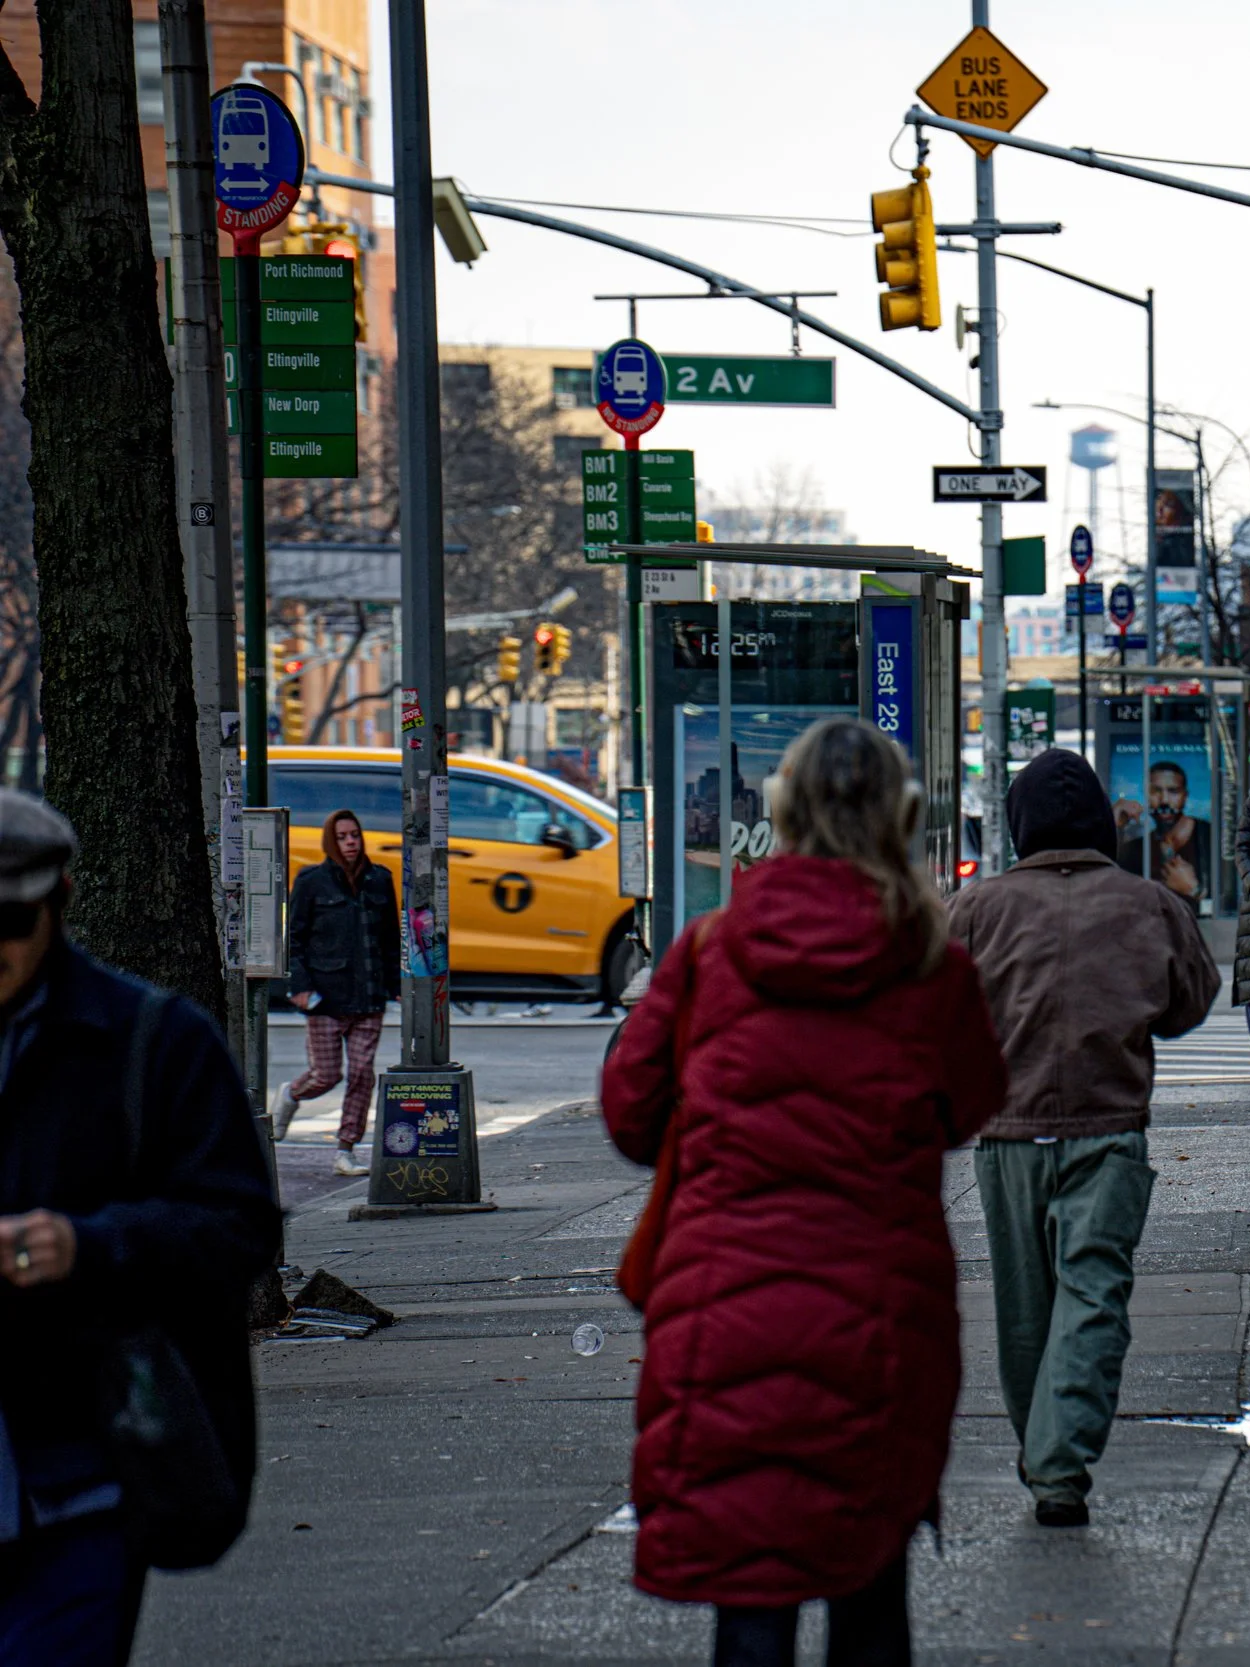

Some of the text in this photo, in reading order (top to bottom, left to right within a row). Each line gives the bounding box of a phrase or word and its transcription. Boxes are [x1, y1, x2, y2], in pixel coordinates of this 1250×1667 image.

[961, 57, 1001, 75] BUS
[954, 79, 1008, 98] LANE
[956, 101, 1008, 119] ENDS
[223, 192, 289, 227] STANDING
[265, 263, 344, 278] Port Richmond
[266, 308, 319, 325] Eltingville
[267, 353, 320, 370] Eltingville
[676, 367, 755, 394] 2 Av
[268, 397, 320, 414] New Dorp
[603, 406, 659, 432] NO STANDING
[269, 442, 322, 459] Eltingville
[585, 453, 616, 474] BM1
[586, 482, 618, 502] BM2
[948, 476, 1028, 492] ONE WAY
[587, 510, 619, 531] BM3
[877, 643, 900, 695] East
[877, 704, 900, 732] 23
[500, 879, 528, 909] T
